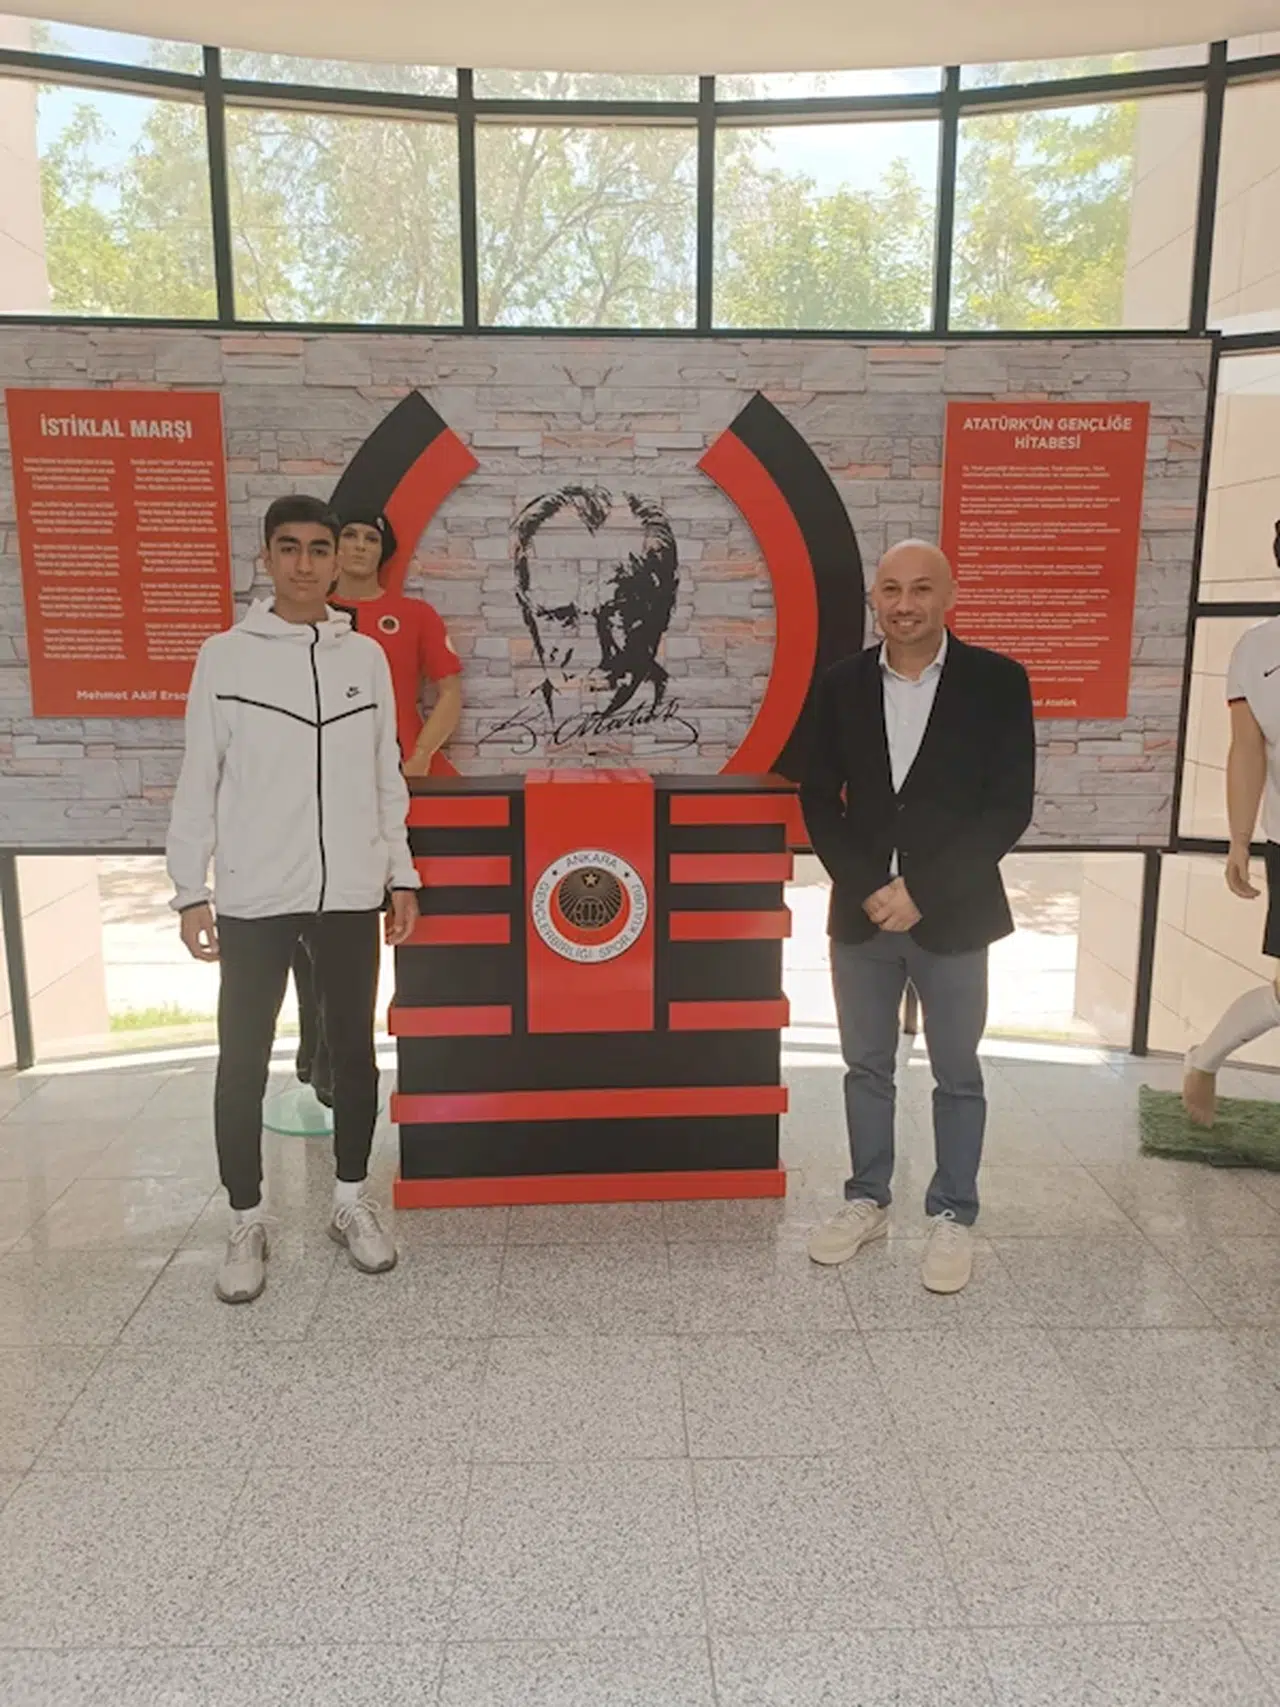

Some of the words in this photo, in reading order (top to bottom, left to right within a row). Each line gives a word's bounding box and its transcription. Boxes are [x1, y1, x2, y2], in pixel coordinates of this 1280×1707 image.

[40, 413, 124, 437] İSTİKLAL
[130, 419, 192, 443] MARŞI
[963, 415, 1053, 430] ATATÜRK'ÜN
[1057, 414, 1133, 432] GENÇLİĞE
[1015, 434, 1081, 449] HİTABESİ
[76, 690, 128, 700] Mehmet
[131, 690, 158, 700] Akif
[160, 690, 191, 700] Erso
[566, 853, 618, 868] ANKARA
